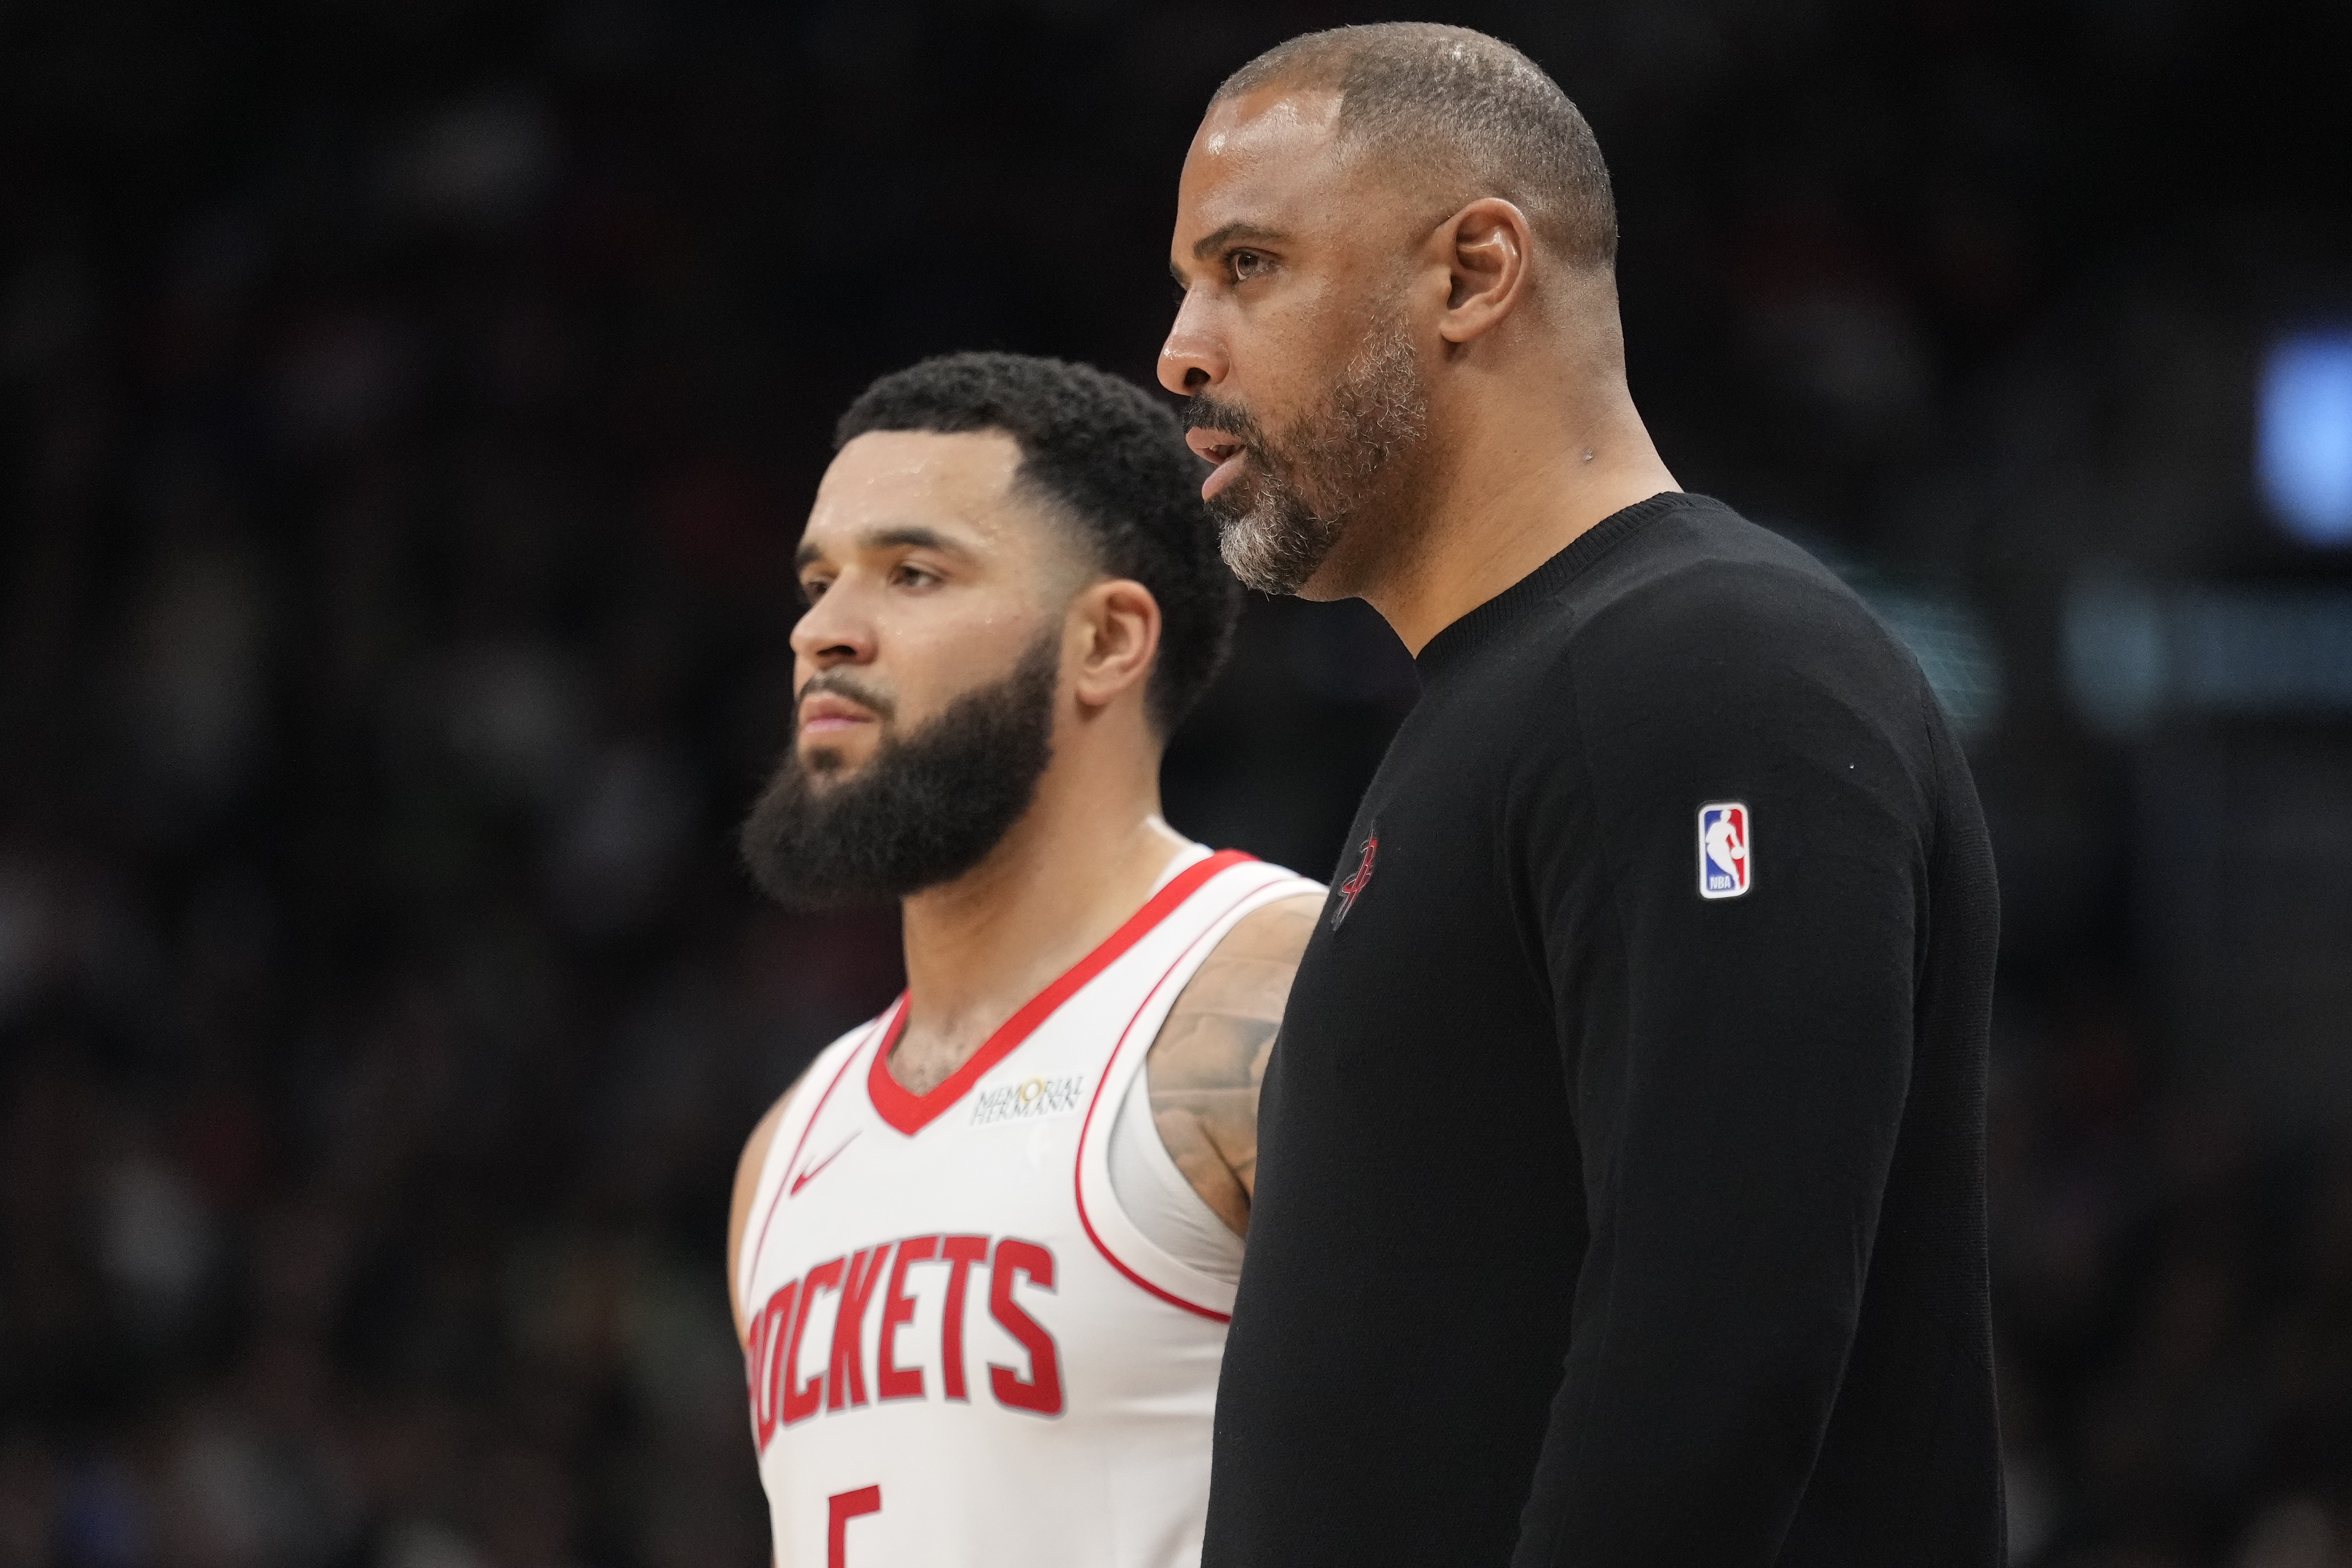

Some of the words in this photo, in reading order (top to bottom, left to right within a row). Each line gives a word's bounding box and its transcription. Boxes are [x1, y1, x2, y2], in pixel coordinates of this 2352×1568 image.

[1710, 875, 1731, 890] NBA
[978, 1077, 1083, 1108] MEMORIAL
[971, 1093, 1079, 1127] HERMANN
